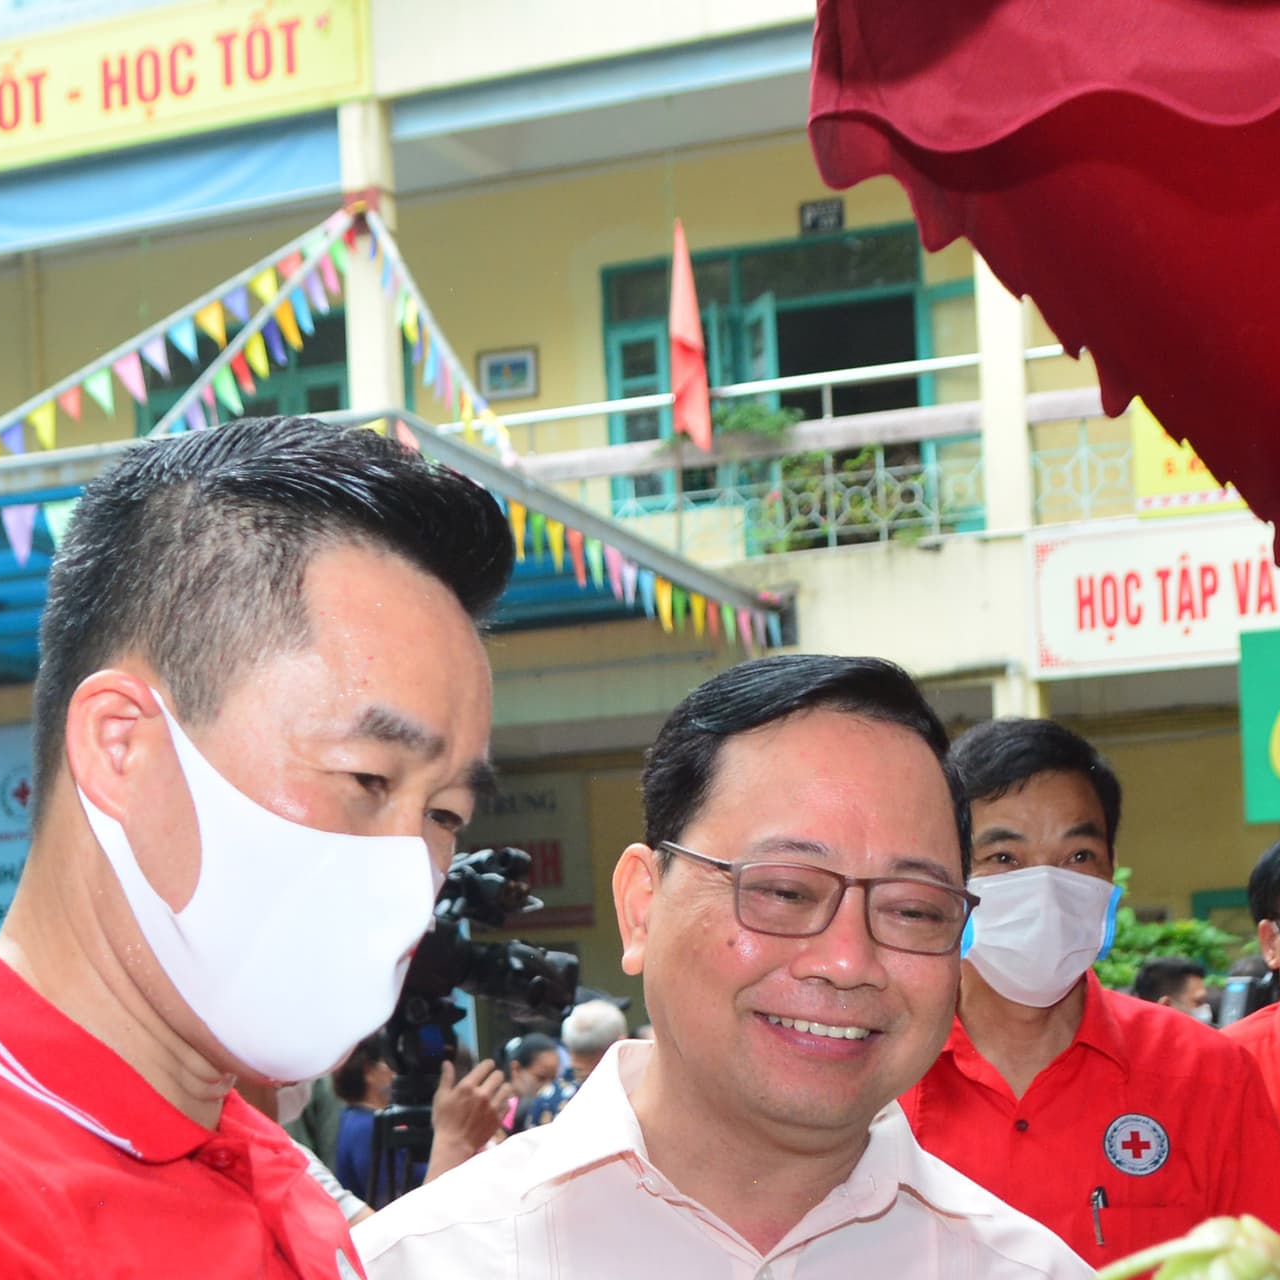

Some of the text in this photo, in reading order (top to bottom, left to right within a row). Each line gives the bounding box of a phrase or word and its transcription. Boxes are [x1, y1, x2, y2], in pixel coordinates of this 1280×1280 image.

[102, 41, 195, 120] HỌC
[1077, 571, 1142, 641] HỌC
[1156, 553, 1218, 635] TẬP
[1232, 546, 1277, 615] VÀ
